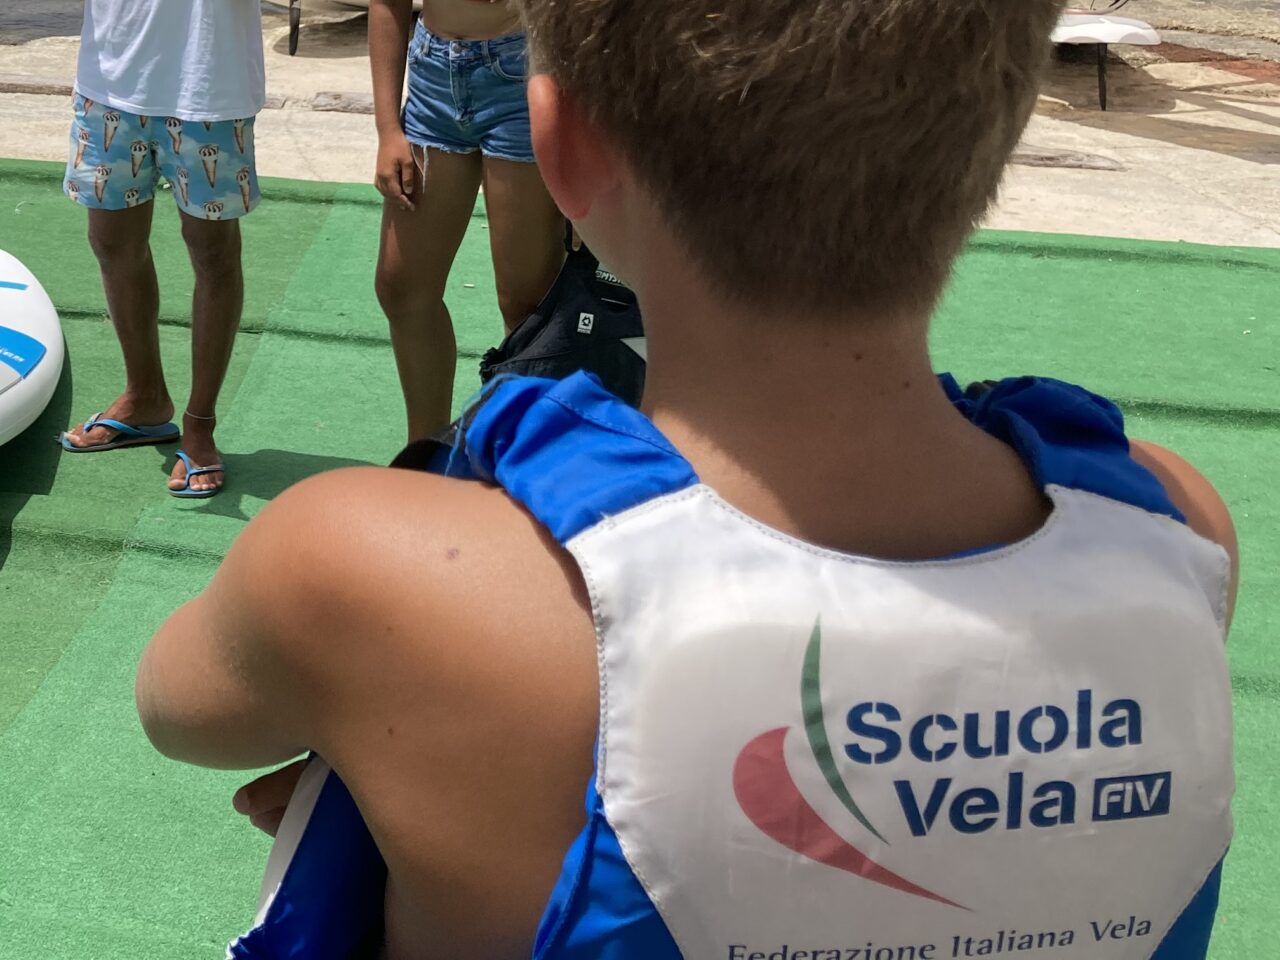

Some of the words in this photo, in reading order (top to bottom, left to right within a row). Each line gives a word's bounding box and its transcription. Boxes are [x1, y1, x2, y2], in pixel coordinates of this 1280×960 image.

[844, 689, 1143, 765] Scuola
[893, 771, 1076, 837] Vela
[1098, 777, 1166, 817] FIV
[727, 942, 936, 960] Federazione
[952, 929, 1074, 958] Italiana
[1090, 915, 1152, 942] Vela
